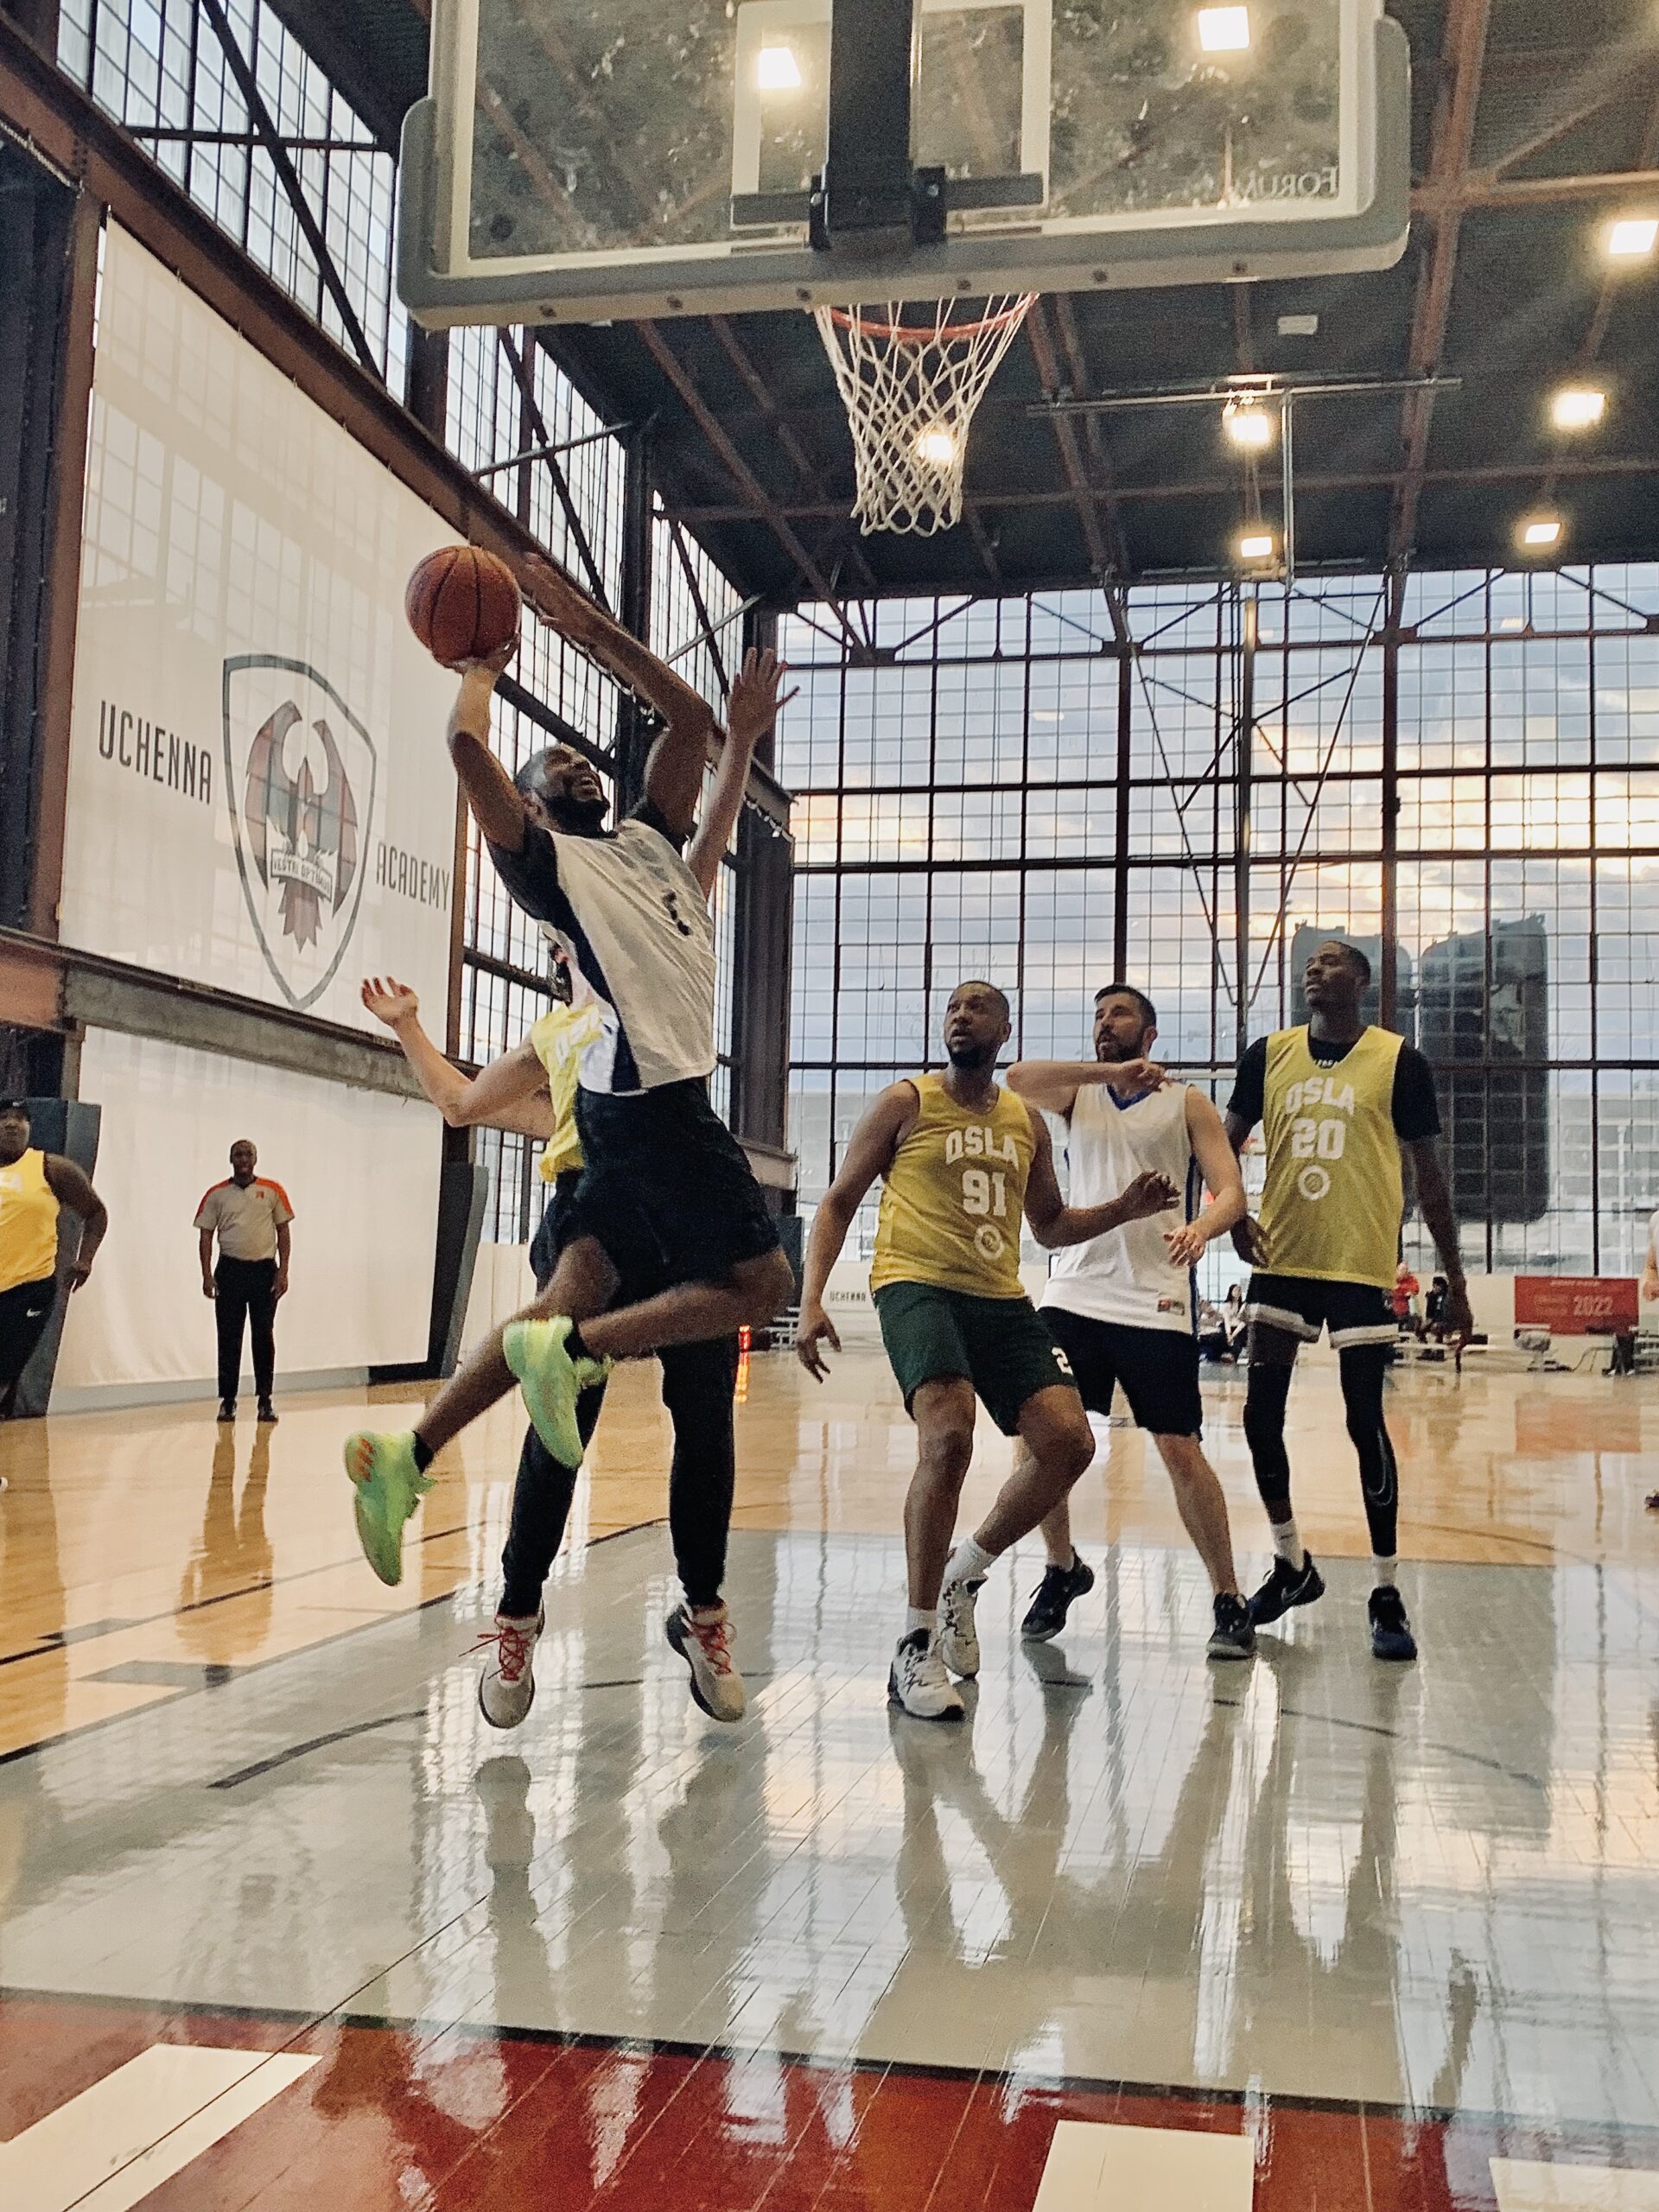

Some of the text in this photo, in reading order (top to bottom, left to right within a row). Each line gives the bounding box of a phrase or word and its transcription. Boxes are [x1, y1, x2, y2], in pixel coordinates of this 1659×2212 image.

[99, 700, 212, 804] UCHENNA
[375, 841, 451, 912] ACADEMY
[1291, 1117, 1346, 1160] 20
[962, 1169, 1007, 1217] 91
